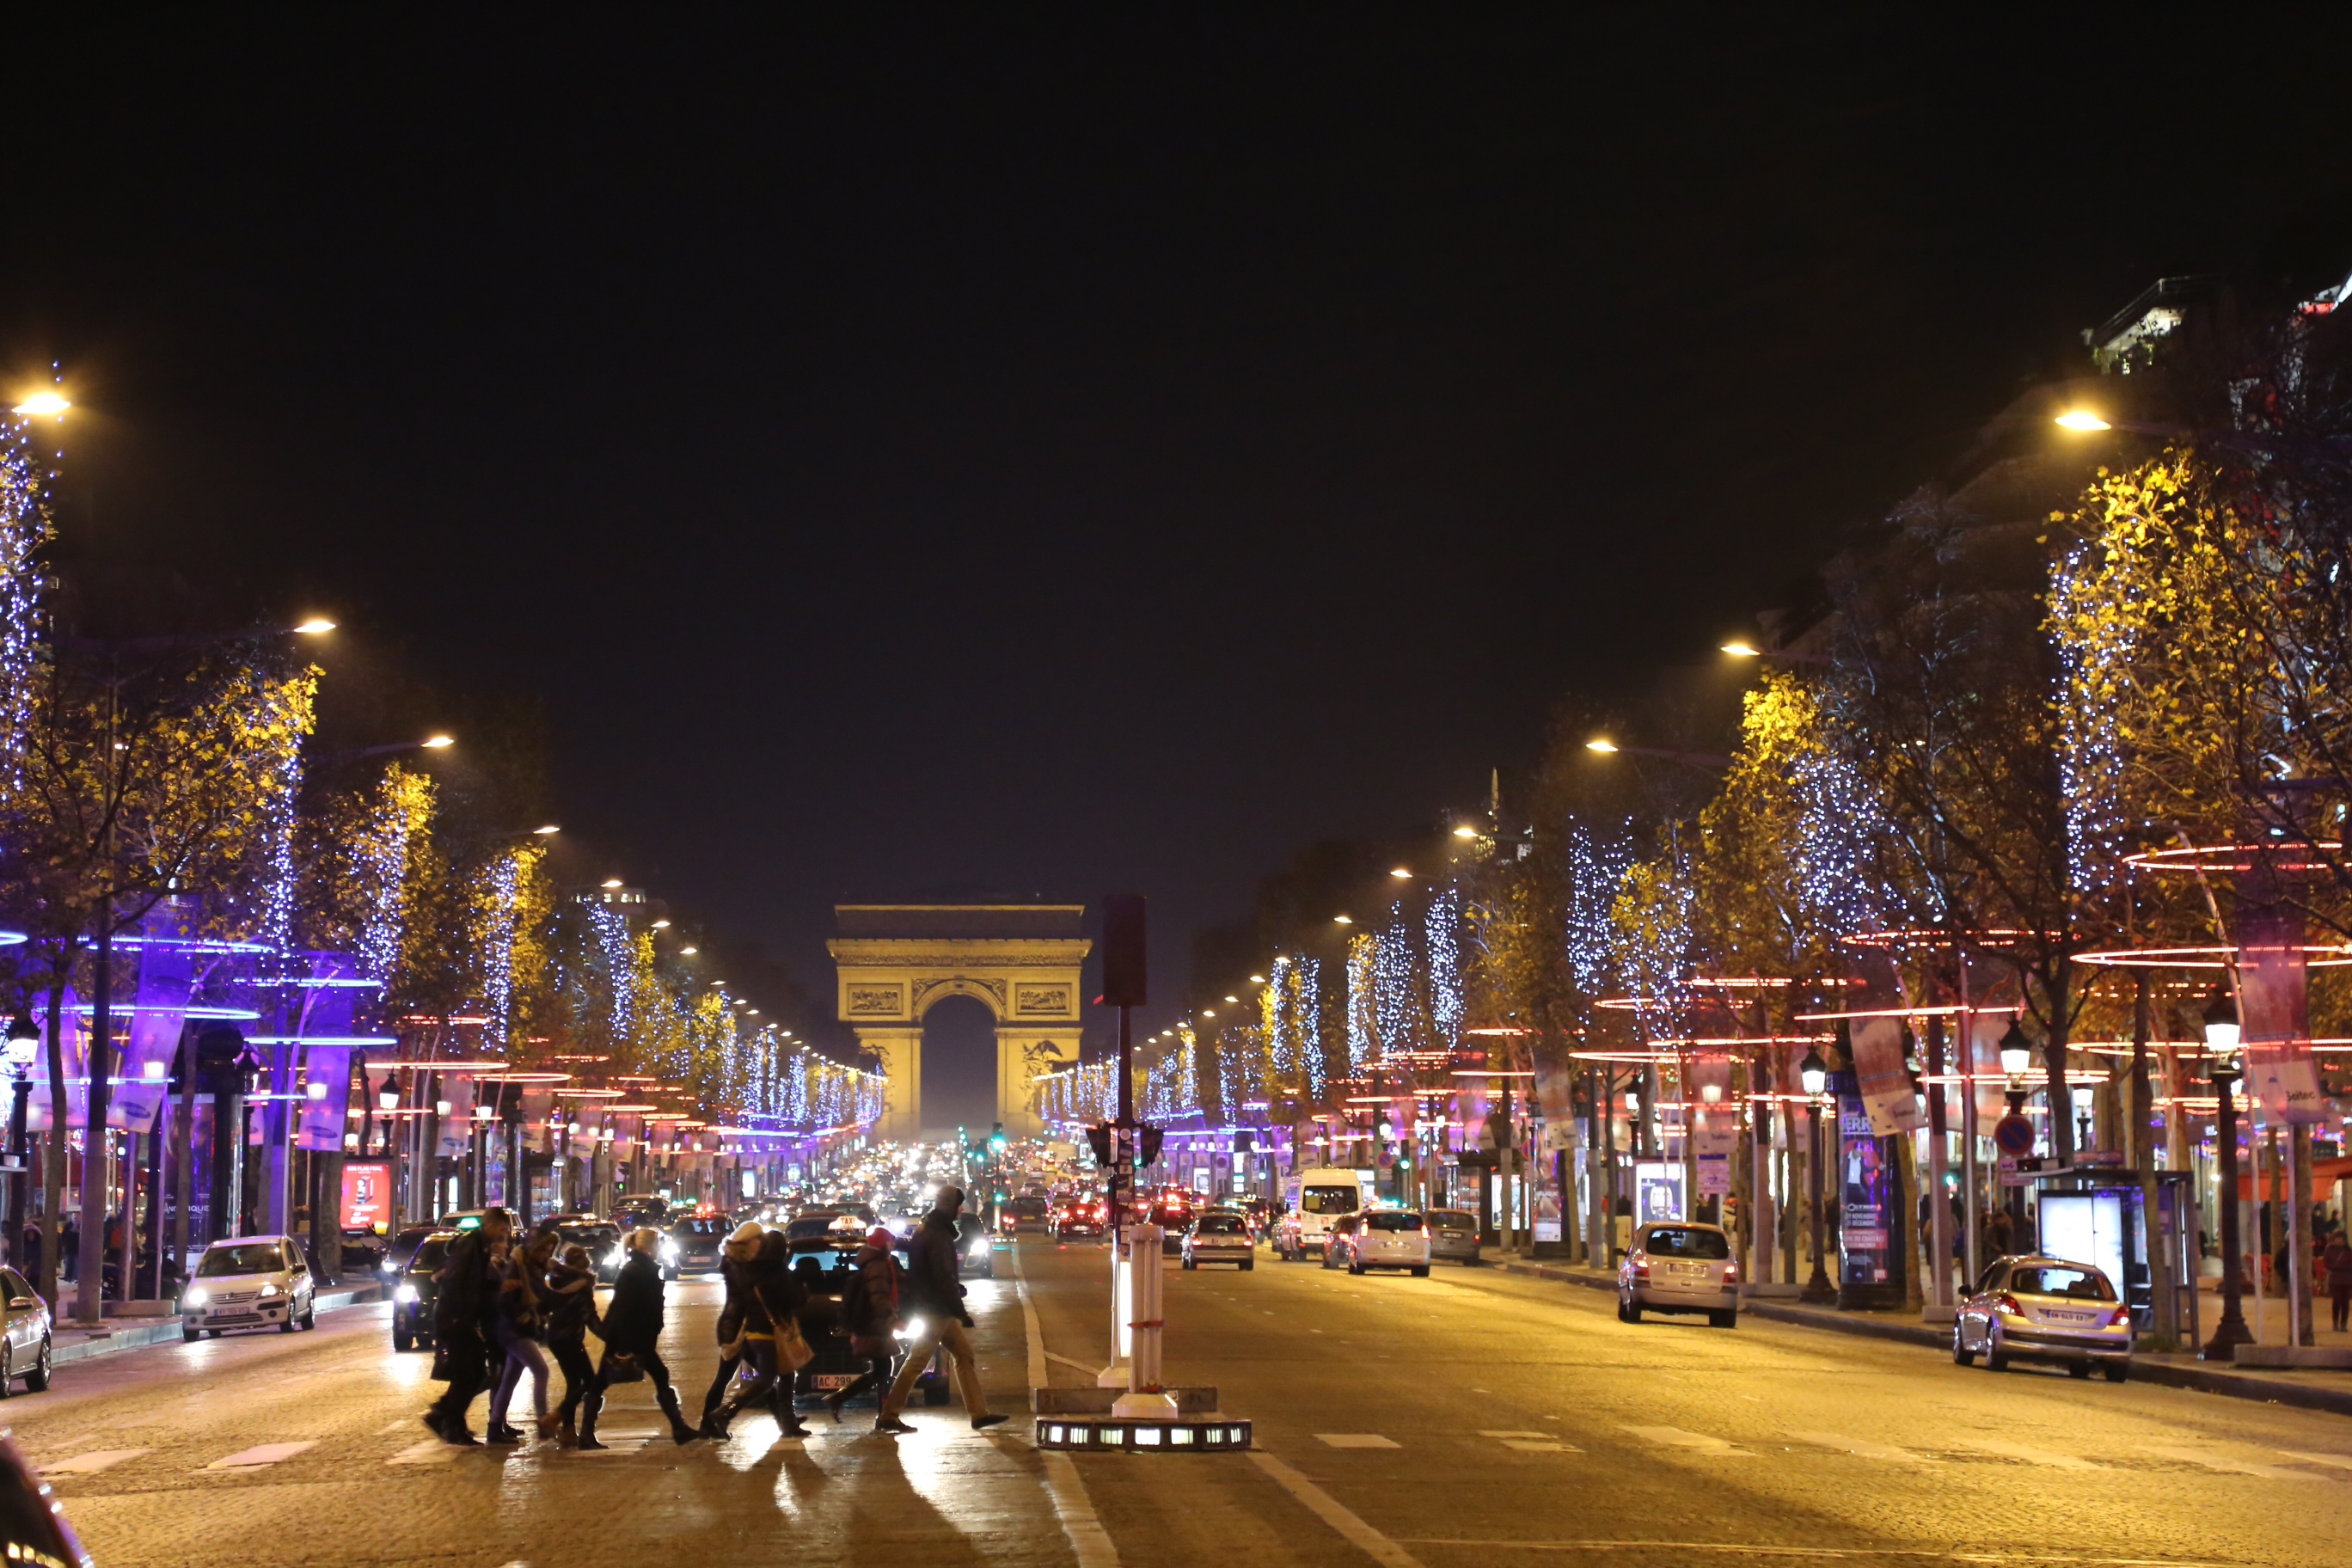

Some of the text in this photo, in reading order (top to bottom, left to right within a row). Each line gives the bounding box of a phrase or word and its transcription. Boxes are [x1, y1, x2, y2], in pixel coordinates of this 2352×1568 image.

[2286, 1091, 2316, 1102] Soitec
[1283, 1167, 1289, 1177] P
[818, 1376, 830, 1387] AC
